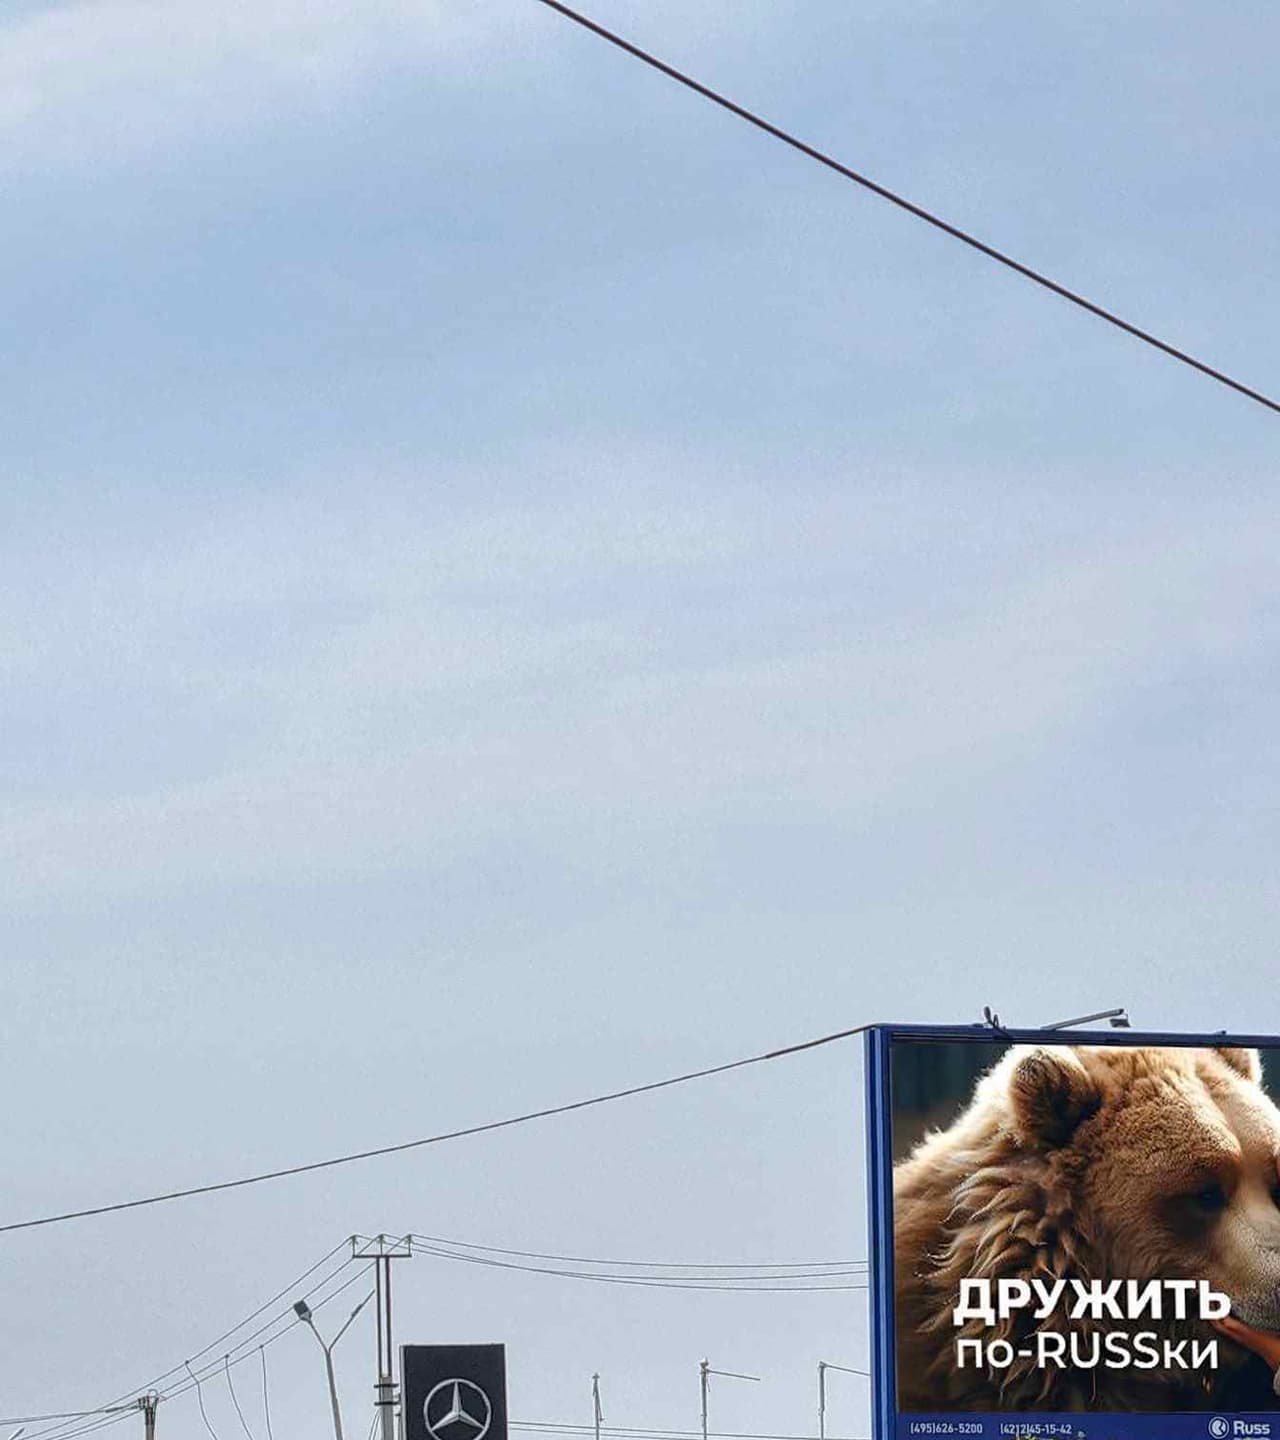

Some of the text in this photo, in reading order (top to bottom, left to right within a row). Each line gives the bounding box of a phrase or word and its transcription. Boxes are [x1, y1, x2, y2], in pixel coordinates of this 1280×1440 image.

[953, 1278, 1232, 1327] ДРУЖИТЬ
[957, 1331, 1219, 1369] по-RUSSки
[910, 1422, 983, 1434] (495)626-5200
[1233, 1420, 1270, 1435] Russ
